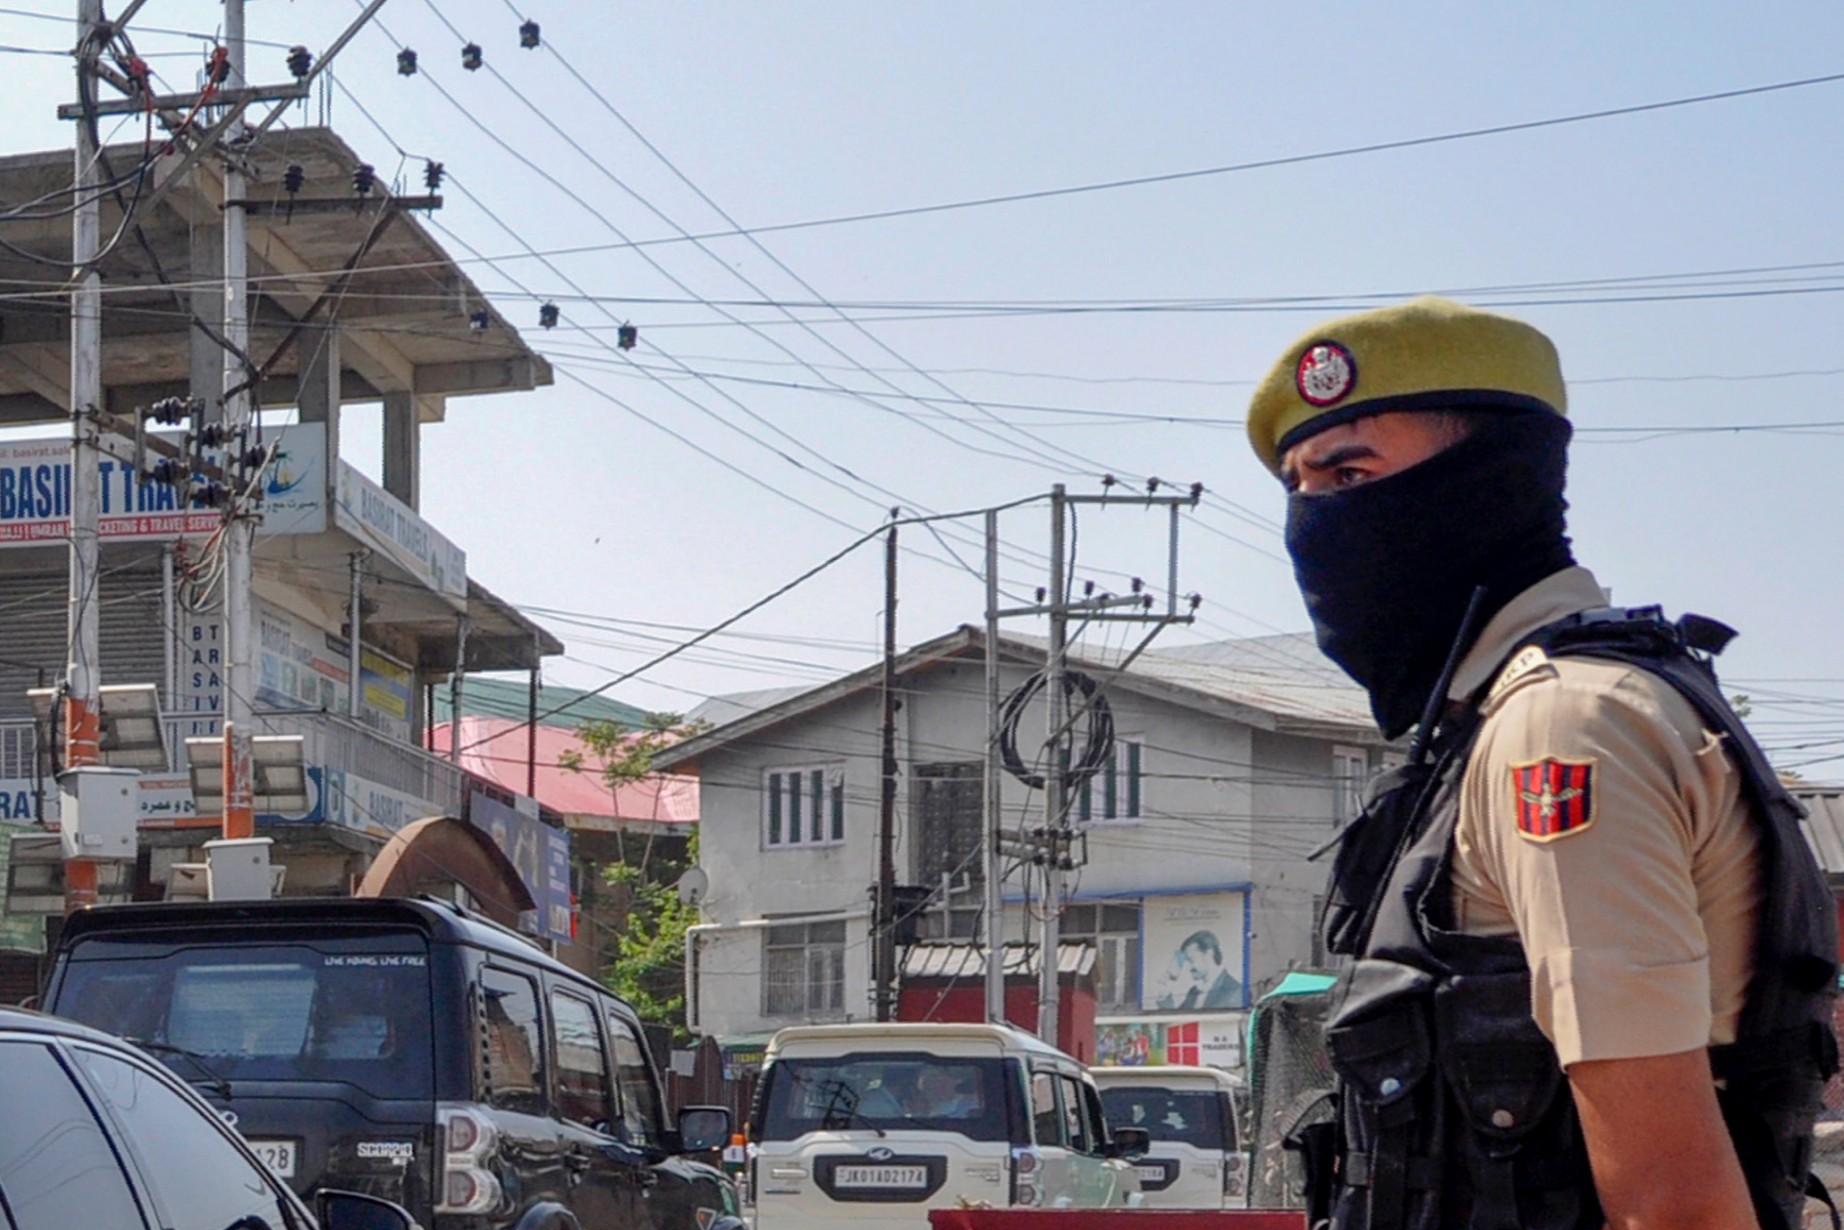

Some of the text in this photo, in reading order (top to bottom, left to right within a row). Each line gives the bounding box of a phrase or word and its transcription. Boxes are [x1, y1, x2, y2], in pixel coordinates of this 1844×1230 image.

[0, 462, 113, 519] BASIT
[140, 520, 148, 532] &
[357, 1142, 413, 1159] SCORPIO
